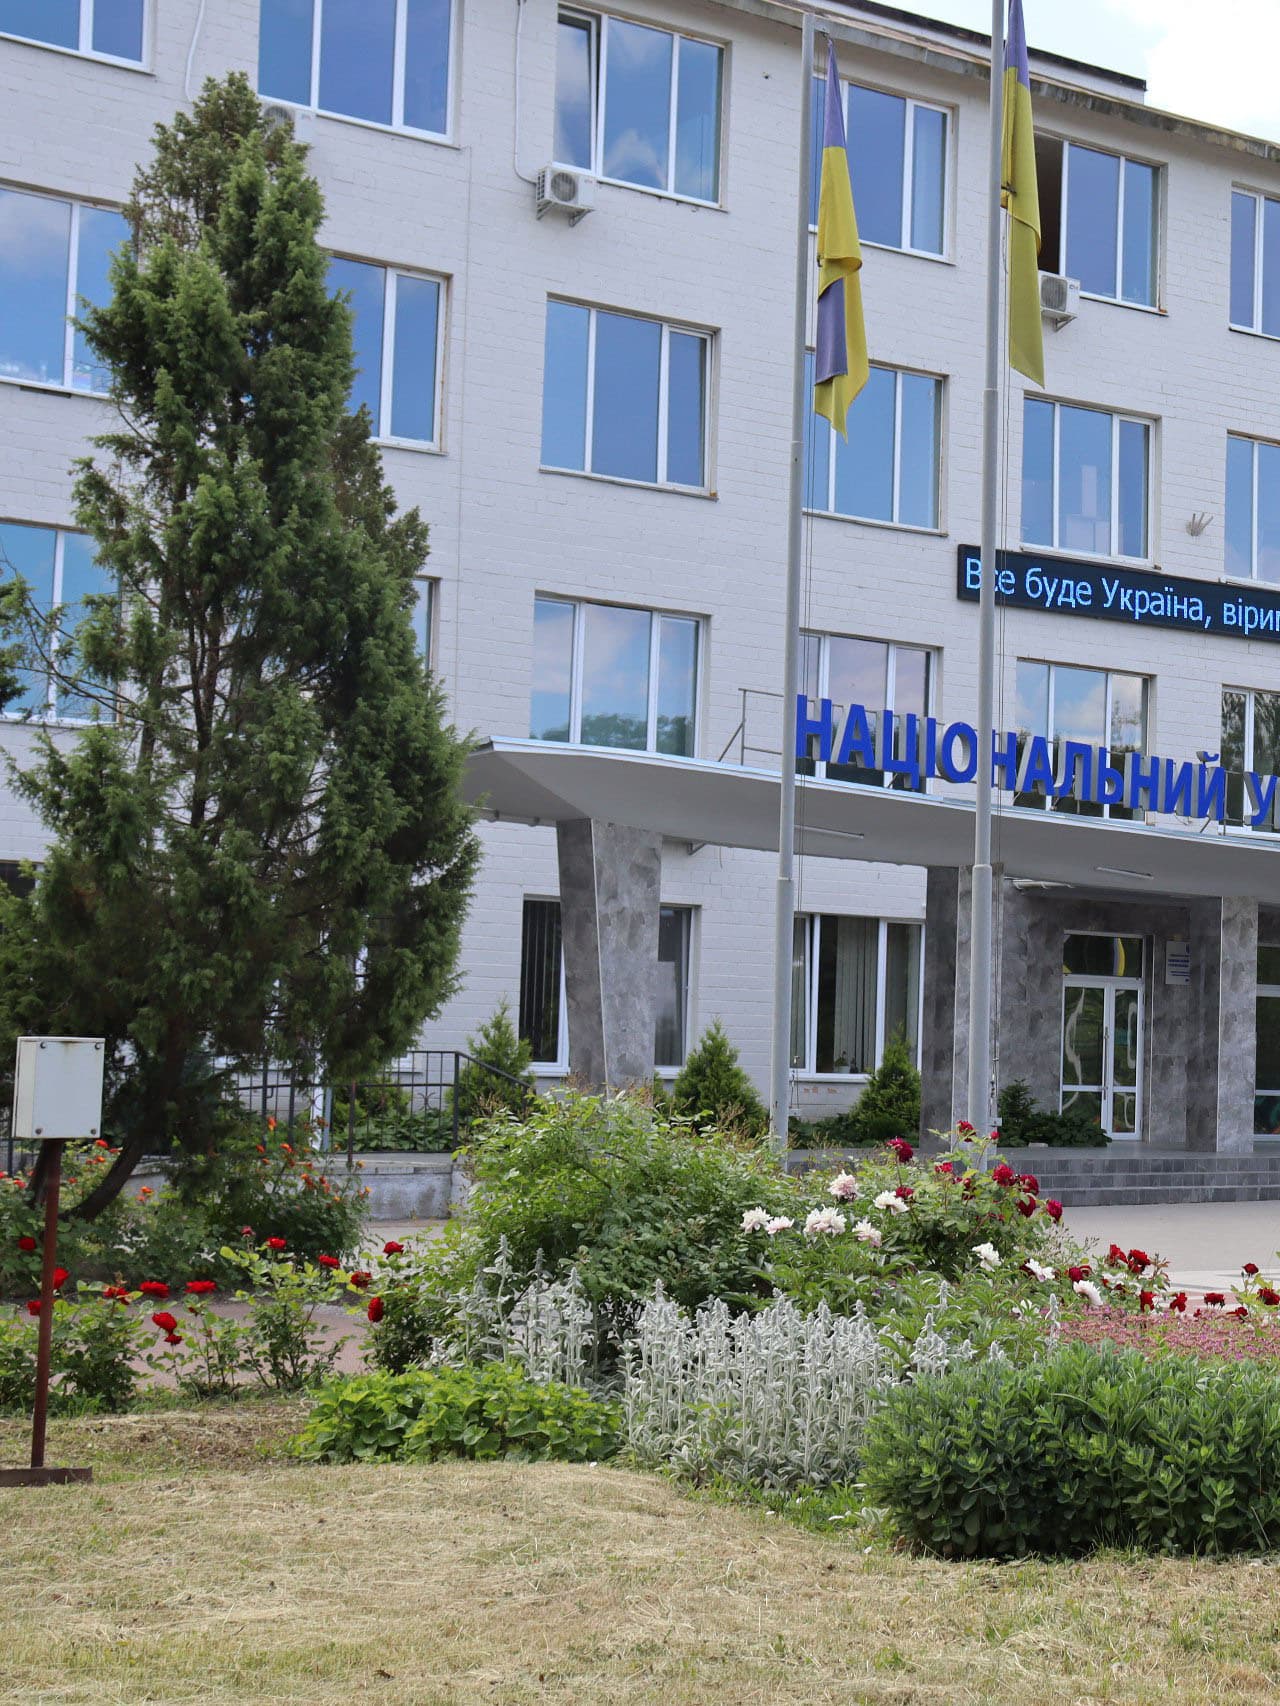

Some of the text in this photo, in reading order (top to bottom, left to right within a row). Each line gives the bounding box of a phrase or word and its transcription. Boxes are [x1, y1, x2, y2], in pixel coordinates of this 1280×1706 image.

[966, 557, 1016, 595] Ве
[1025, 567, 1093, 609] буде
[1101, 577, 1212, 629] Україна,
[796, 693, 1226, 821] НАЦІОНАЛЬНИЙ
